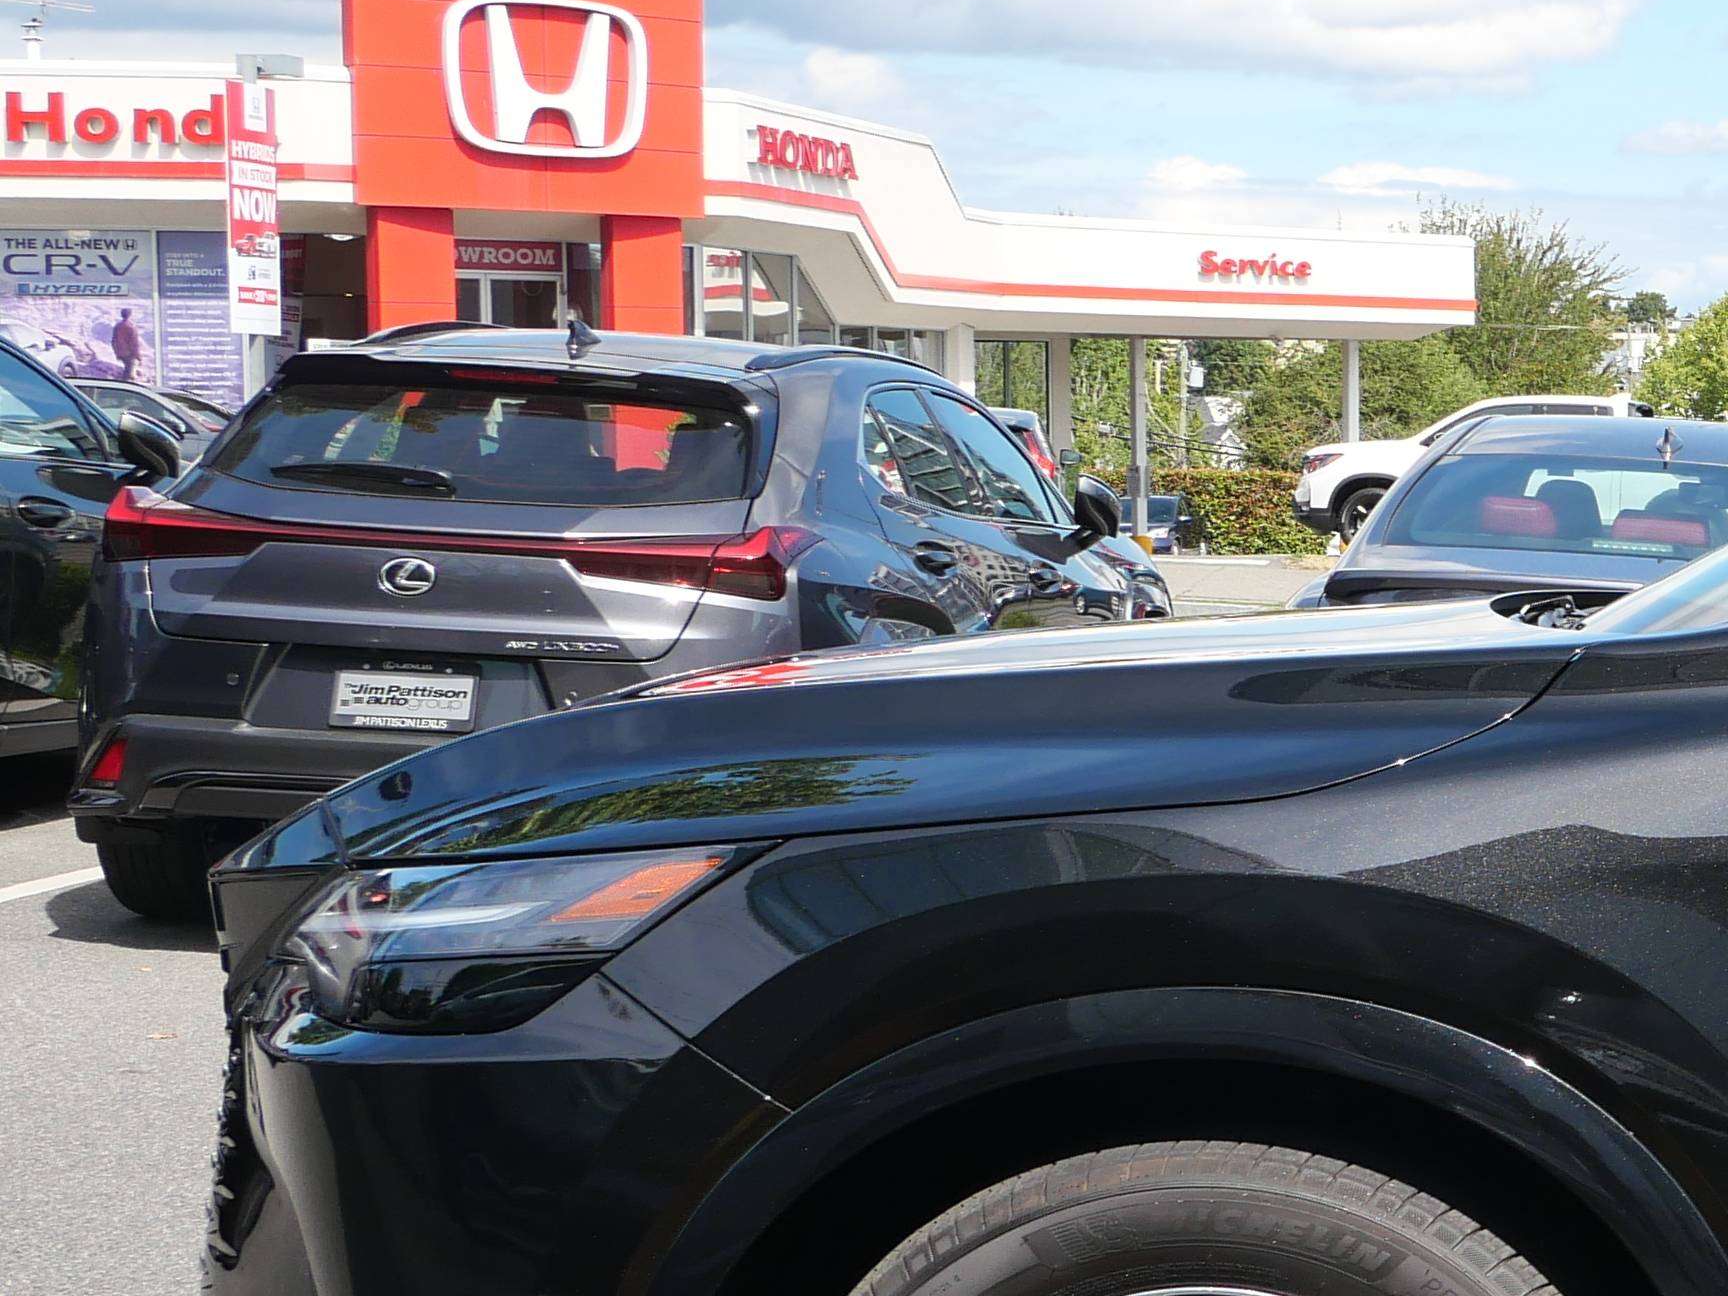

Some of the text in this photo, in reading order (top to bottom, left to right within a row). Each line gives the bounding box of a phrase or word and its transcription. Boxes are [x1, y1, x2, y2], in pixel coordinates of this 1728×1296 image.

[6, 92, 224, 144] Hond
[757, 125, 859, 180] HONDA
[234, 187, 276, 223] NOW
[4, 238, 119, 250] THE ALL-NEW
[3, 254, 139, 276] CR-V
[455, 246, 556, 265] WROOM
[1200, 250, 1312, 277] Service
[33, 285, 122, 294] HYBRID
[351, 683, 384, 696] Jim
[387, 685, 468, 699] Pattison
[370, 717, 416, 727] PATTISON
[417, 719, 448, 729] LEXUS
